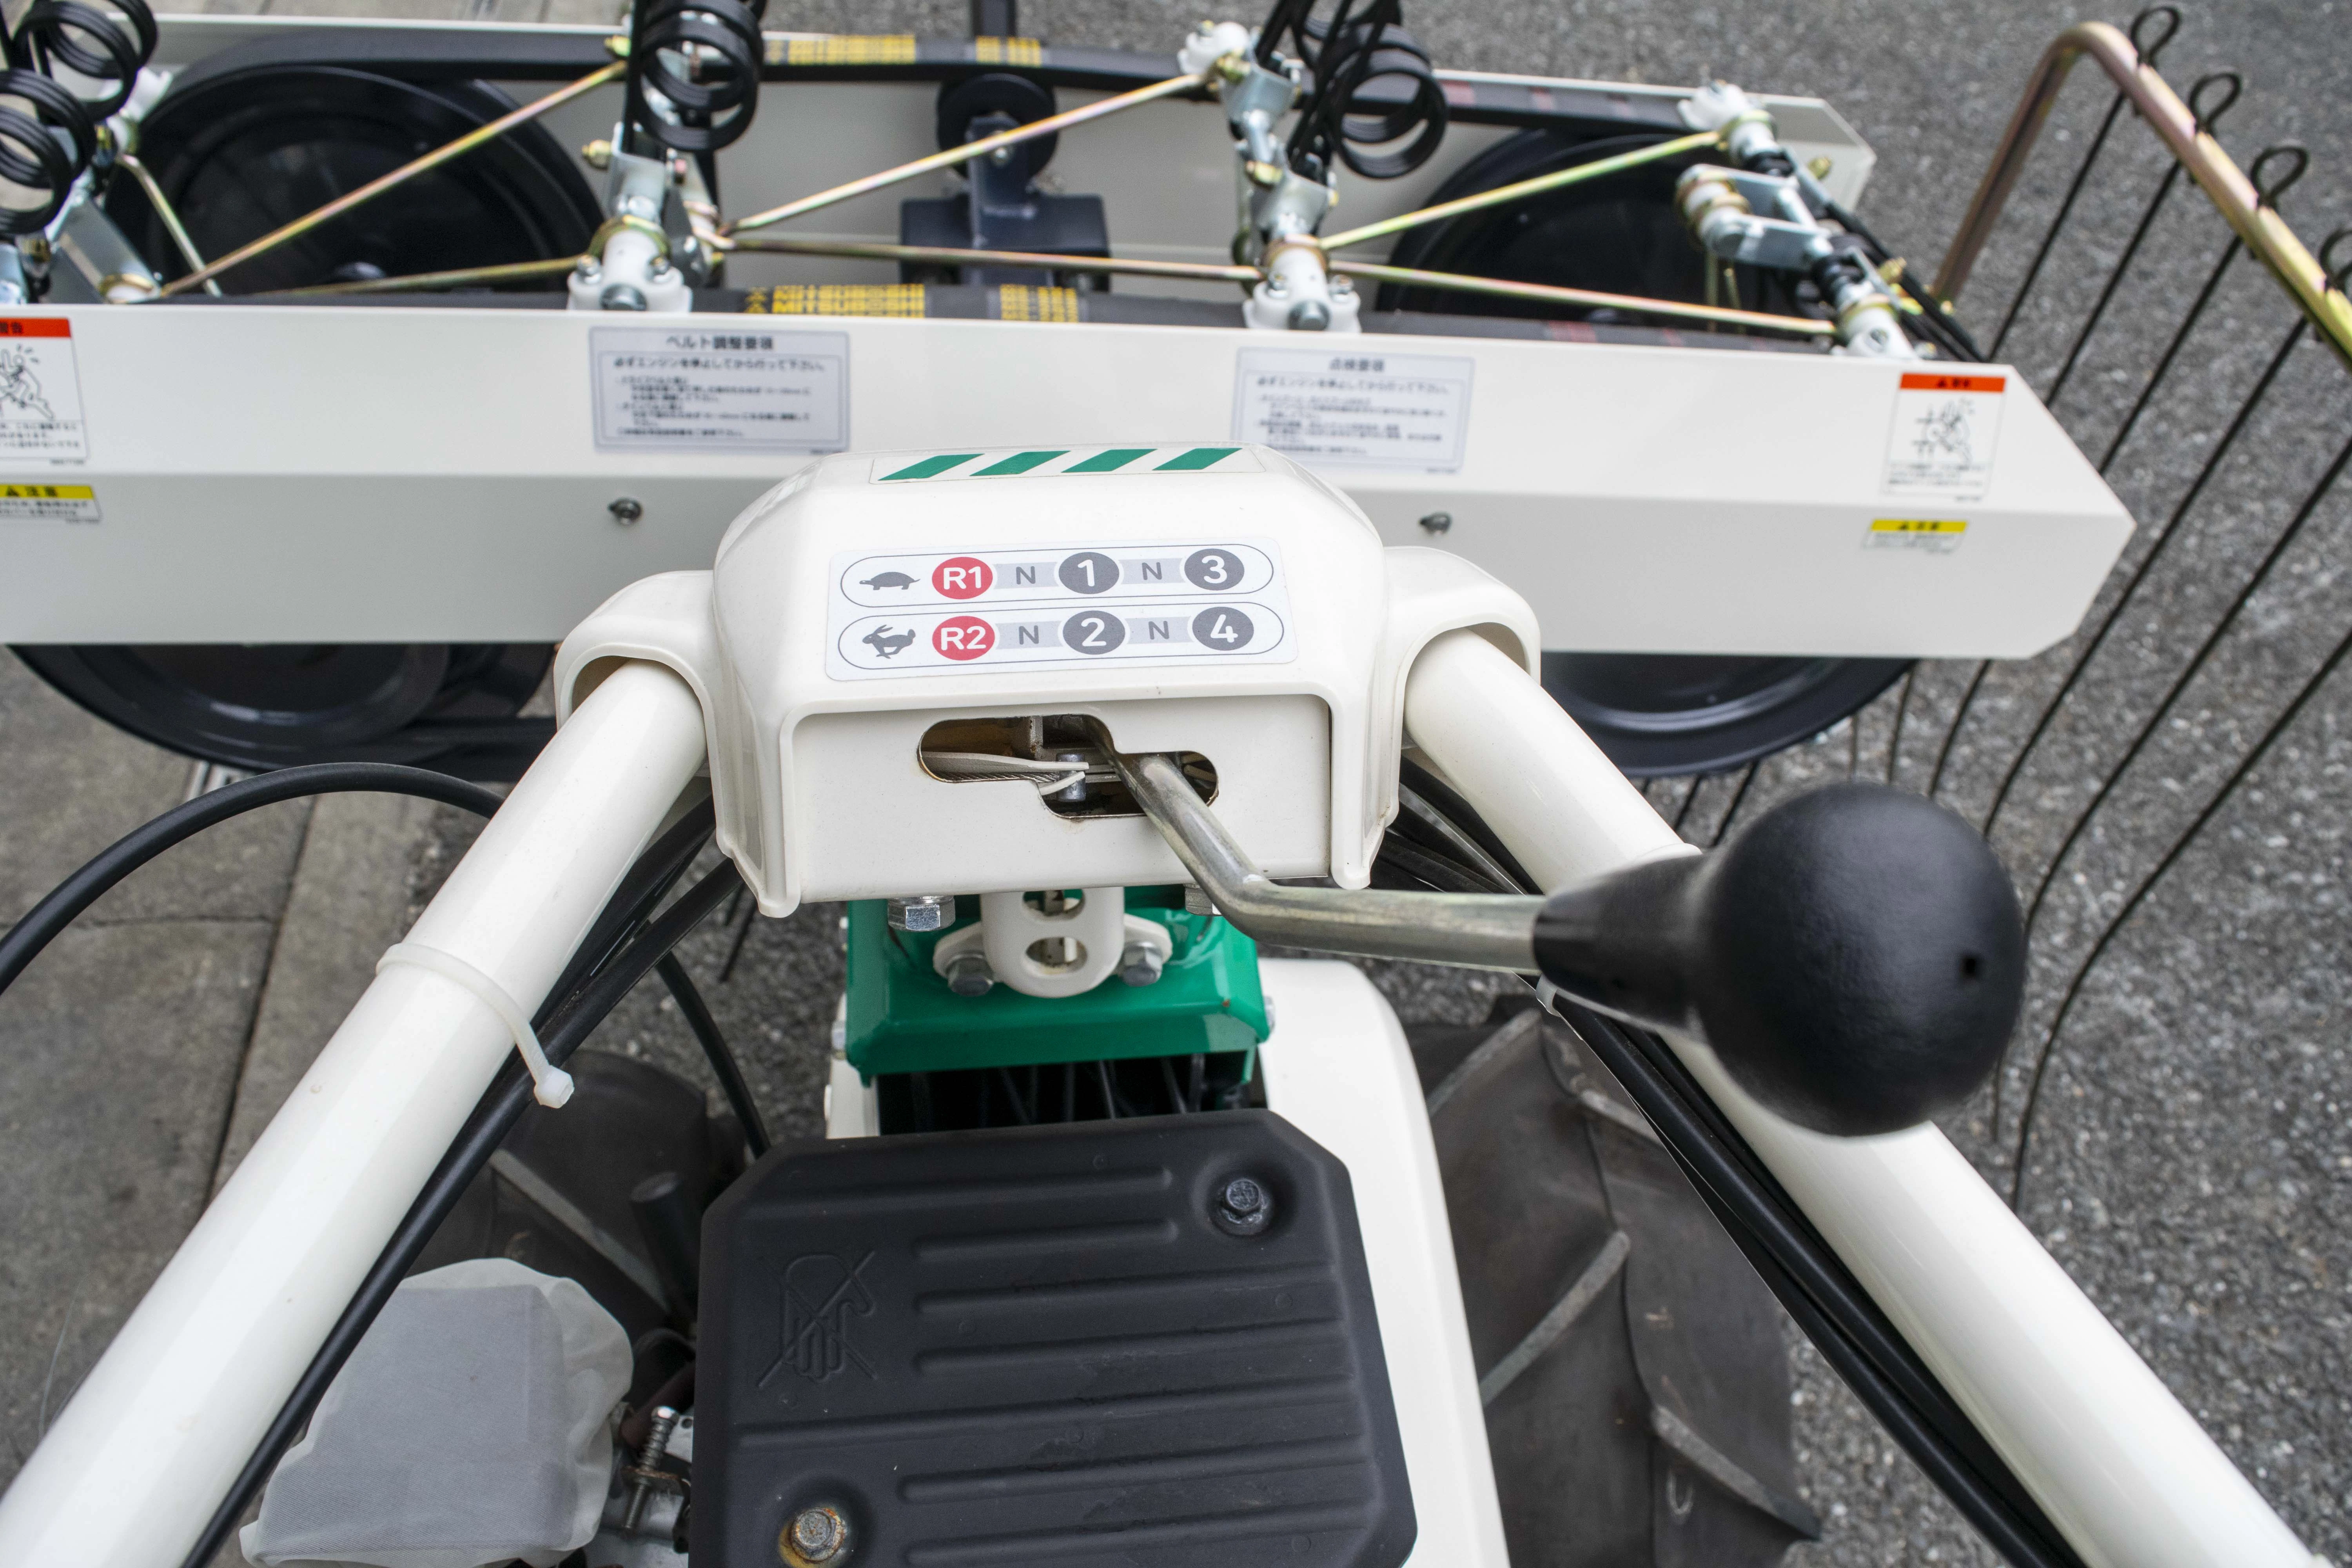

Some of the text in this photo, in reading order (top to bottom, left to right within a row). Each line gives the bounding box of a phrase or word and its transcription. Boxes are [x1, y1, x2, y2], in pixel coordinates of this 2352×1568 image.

[943, 555, 1228, 590] R1 N 1 N 3
[940, 613, 1239, 651] R2 N 2 N 4
